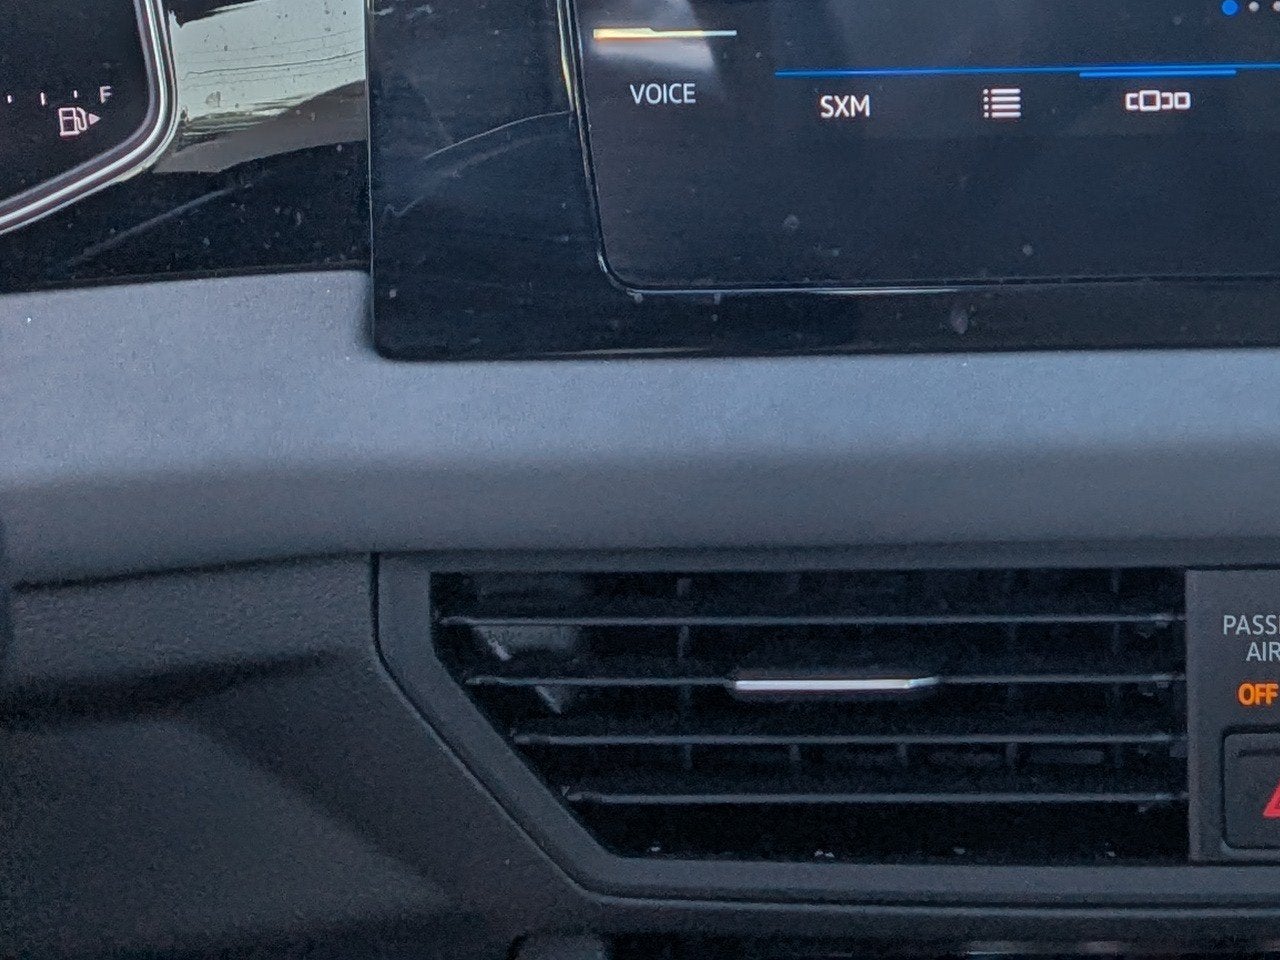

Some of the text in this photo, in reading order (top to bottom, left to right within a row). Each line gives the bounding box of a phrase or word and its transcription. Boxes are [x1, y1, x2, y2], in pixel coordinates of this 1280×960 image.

[99, 85, 112, 104] F
[629, 82, 696, 105] VOICE
[820, 94, 871, 118] SXM
[1238, 683, 1279, 706] OFF
